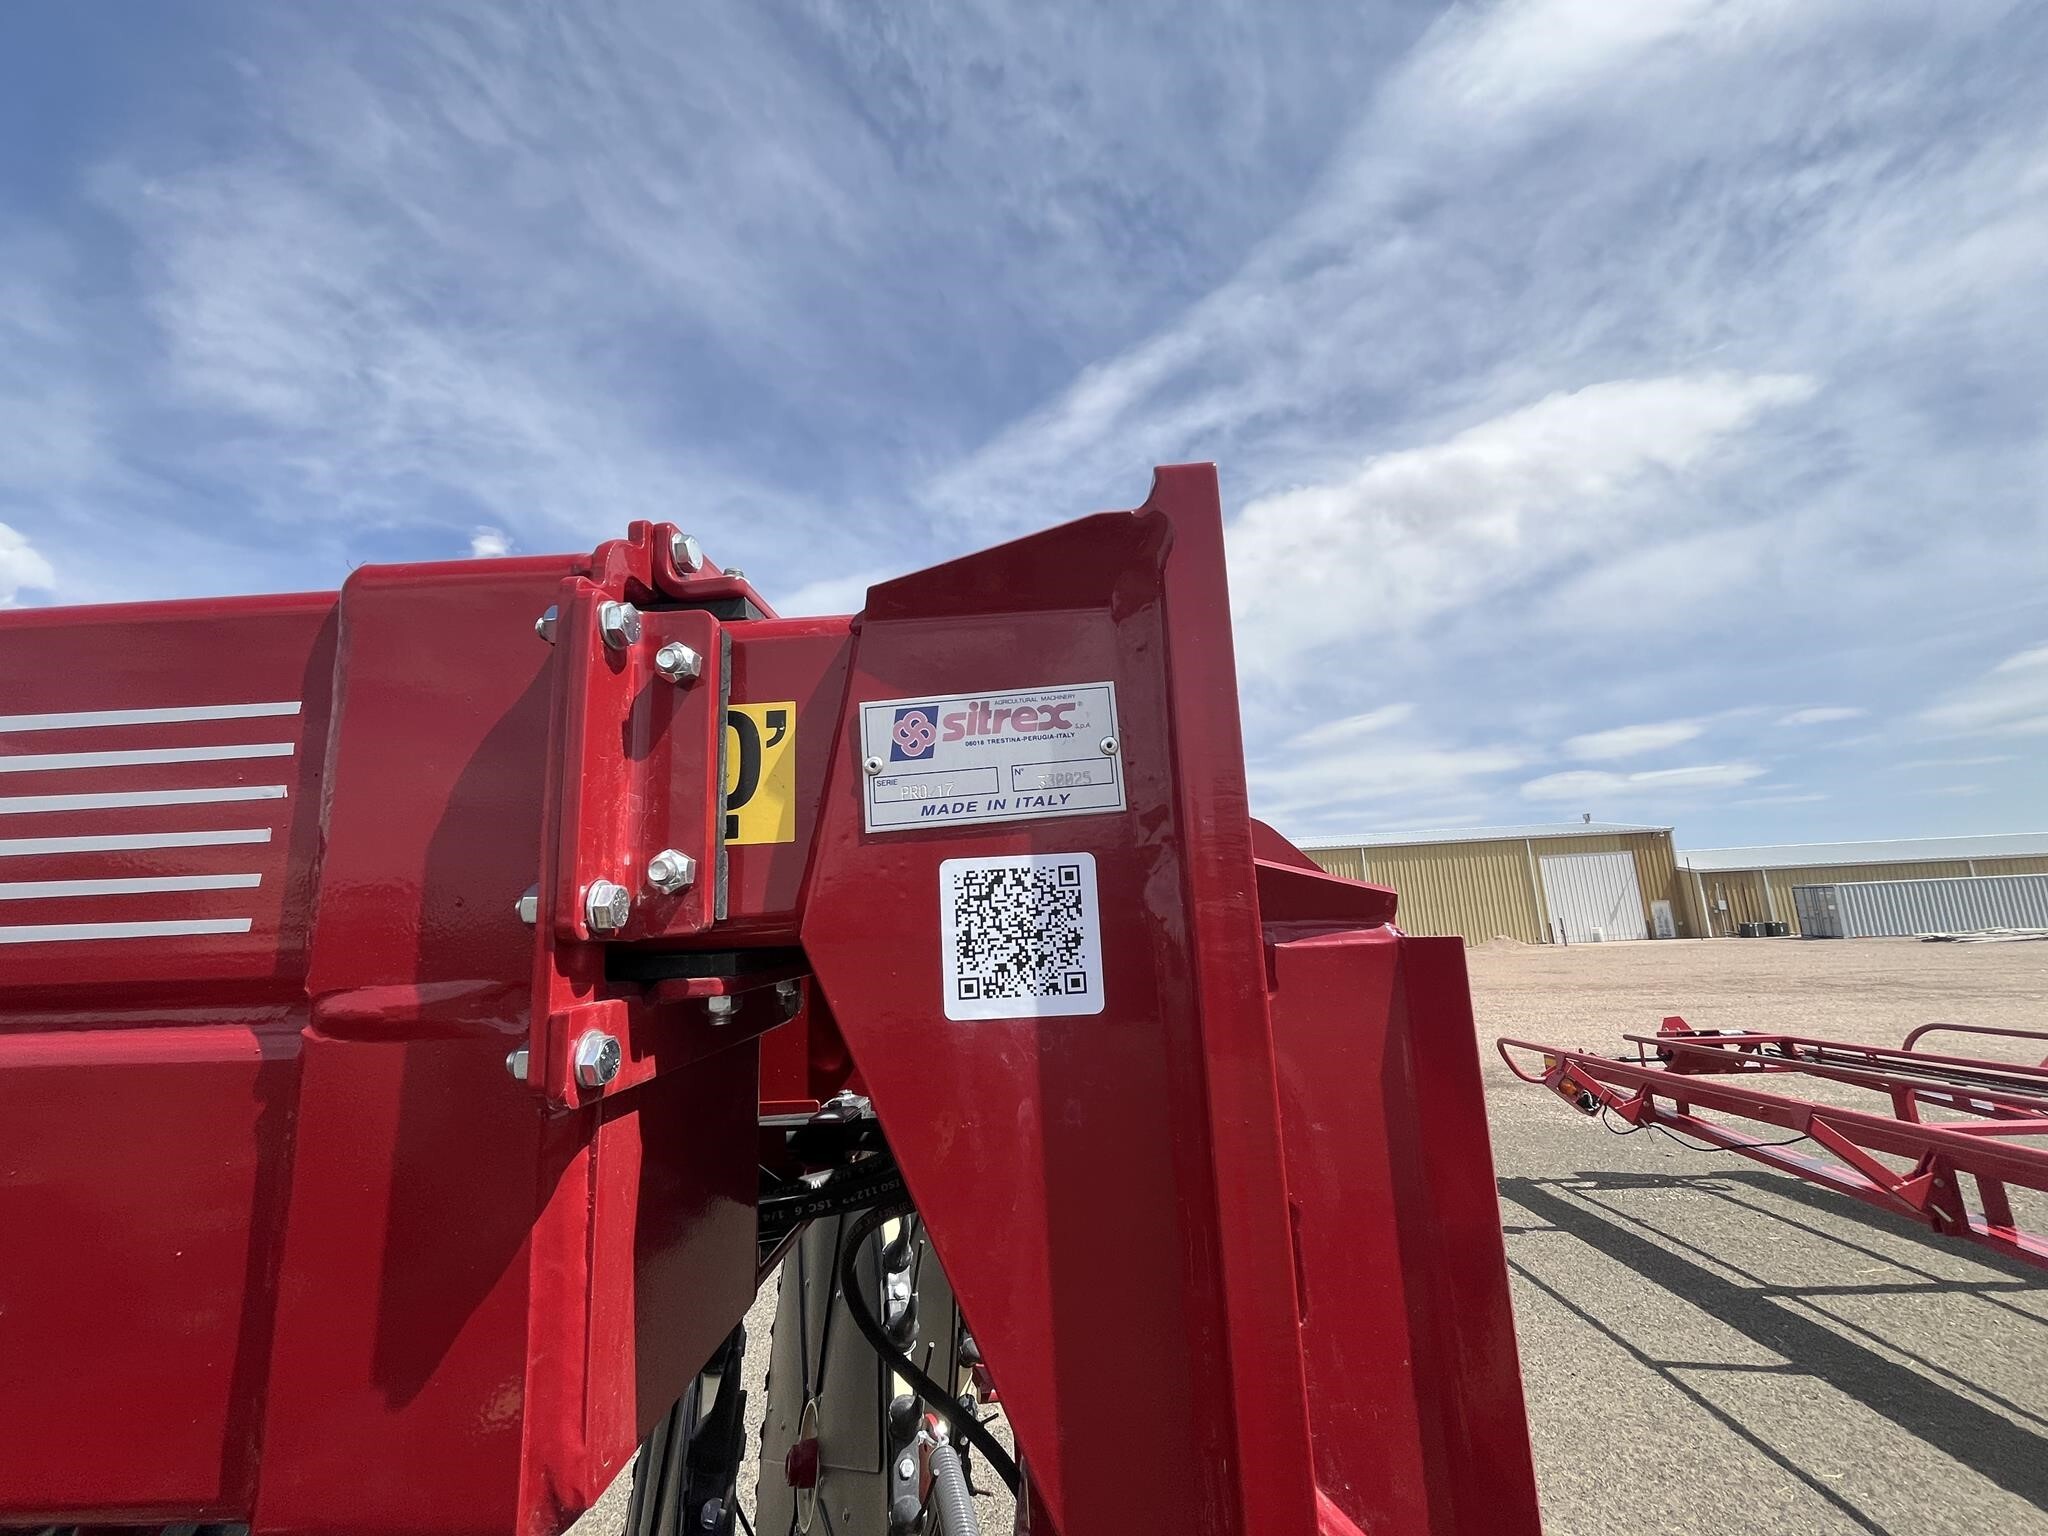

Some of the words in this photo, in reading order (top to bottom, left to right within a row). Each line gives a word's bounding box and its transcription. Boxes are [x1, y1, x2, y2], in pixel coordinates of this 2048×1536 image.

[994, 697, 1038, 706] AGRICULTURAL
[1040, 693, 1076, 702] MACHINERY
[942, 700, 1076, 742] sitrex
[965, 739, 985, 747] 06018
[987, 732, 1075, 745] TRESTINA-PERUGIA-ITALY
[876, 778, 898, 787] SERIE
[921, 801, 978, 816] MADE
[987, 799, 1007, 811] IN
[1016, 793, 1071, 809] ITALY
